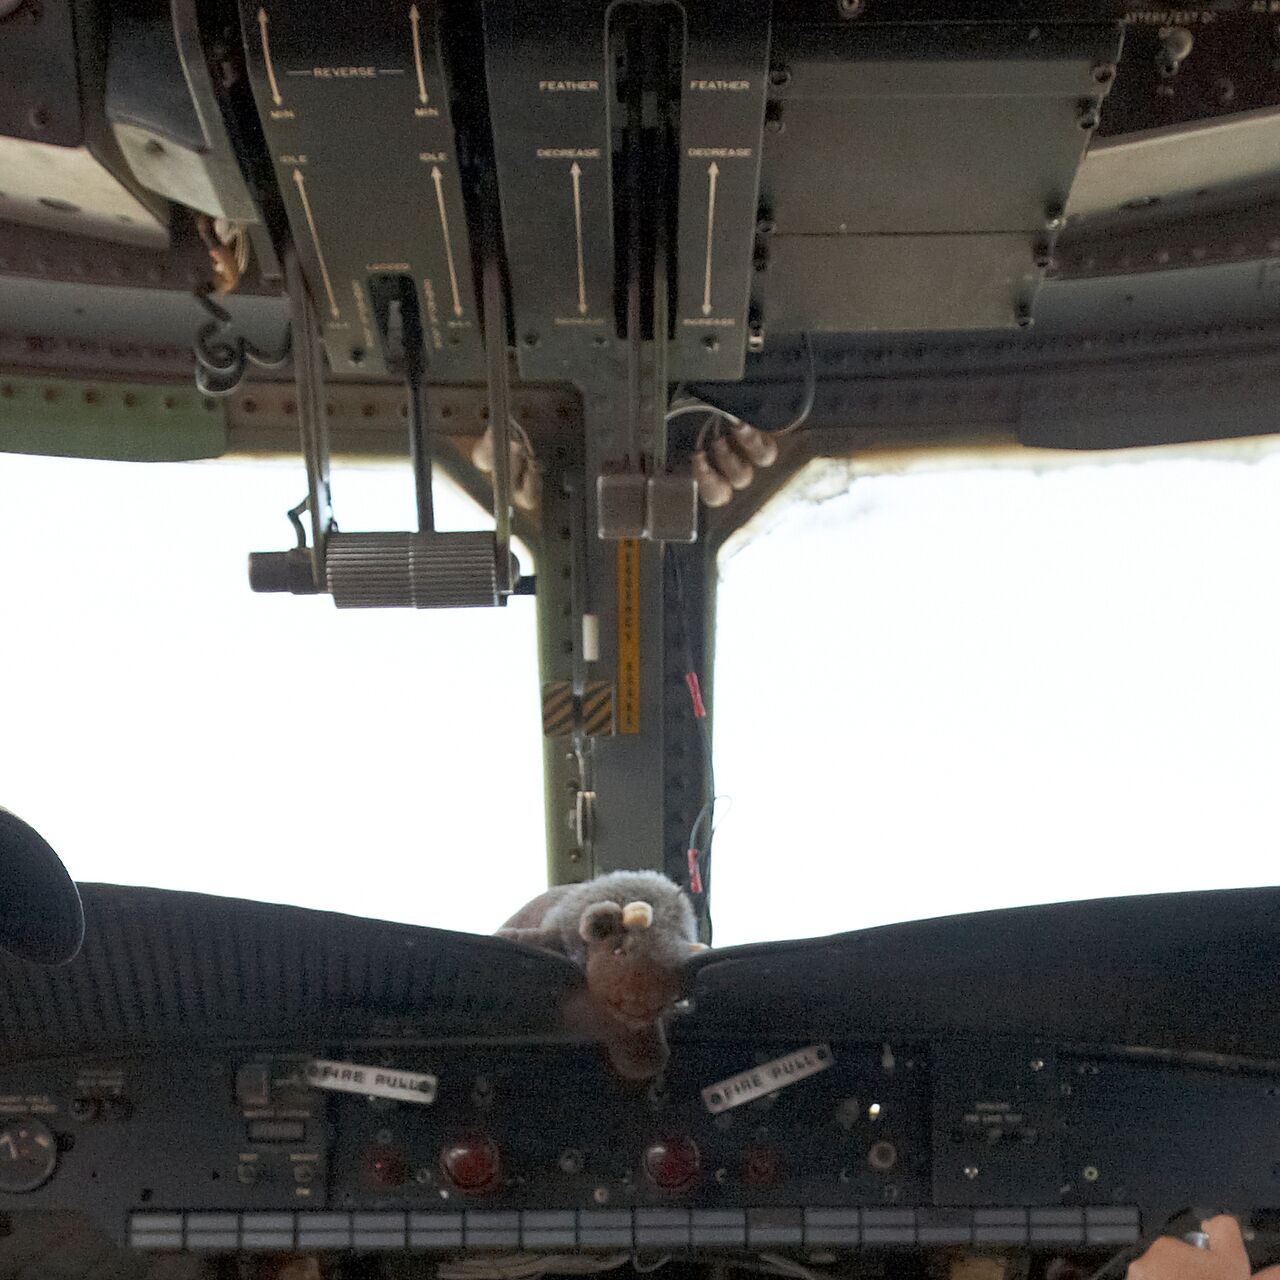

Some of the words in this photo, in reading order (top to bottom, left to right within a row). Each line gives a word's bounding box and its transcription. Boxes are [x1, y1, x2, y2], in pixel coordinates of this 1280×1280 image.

[313, 66, 377, 78] REVERSE
[538, 80, 599, 91] FEATHER
[689, 80, 750, 91] FEATHER
[270, 110, 296, 120] MIN
[414, 107, 439, 117] MIN
[279, 153, 308, 164] IDLE
[419, 152, 448, 162] IDLE
[536, 148, 601, 158] DECREASE
[687, 148, 752, 158] DECREASE
[322, 1065, 365, 1084] FIRE
[375, 1073, 418, 1091] PULL
[723, 1074, 763, 1101] FIRE
[771, 1055, 815, 1079] PULL
